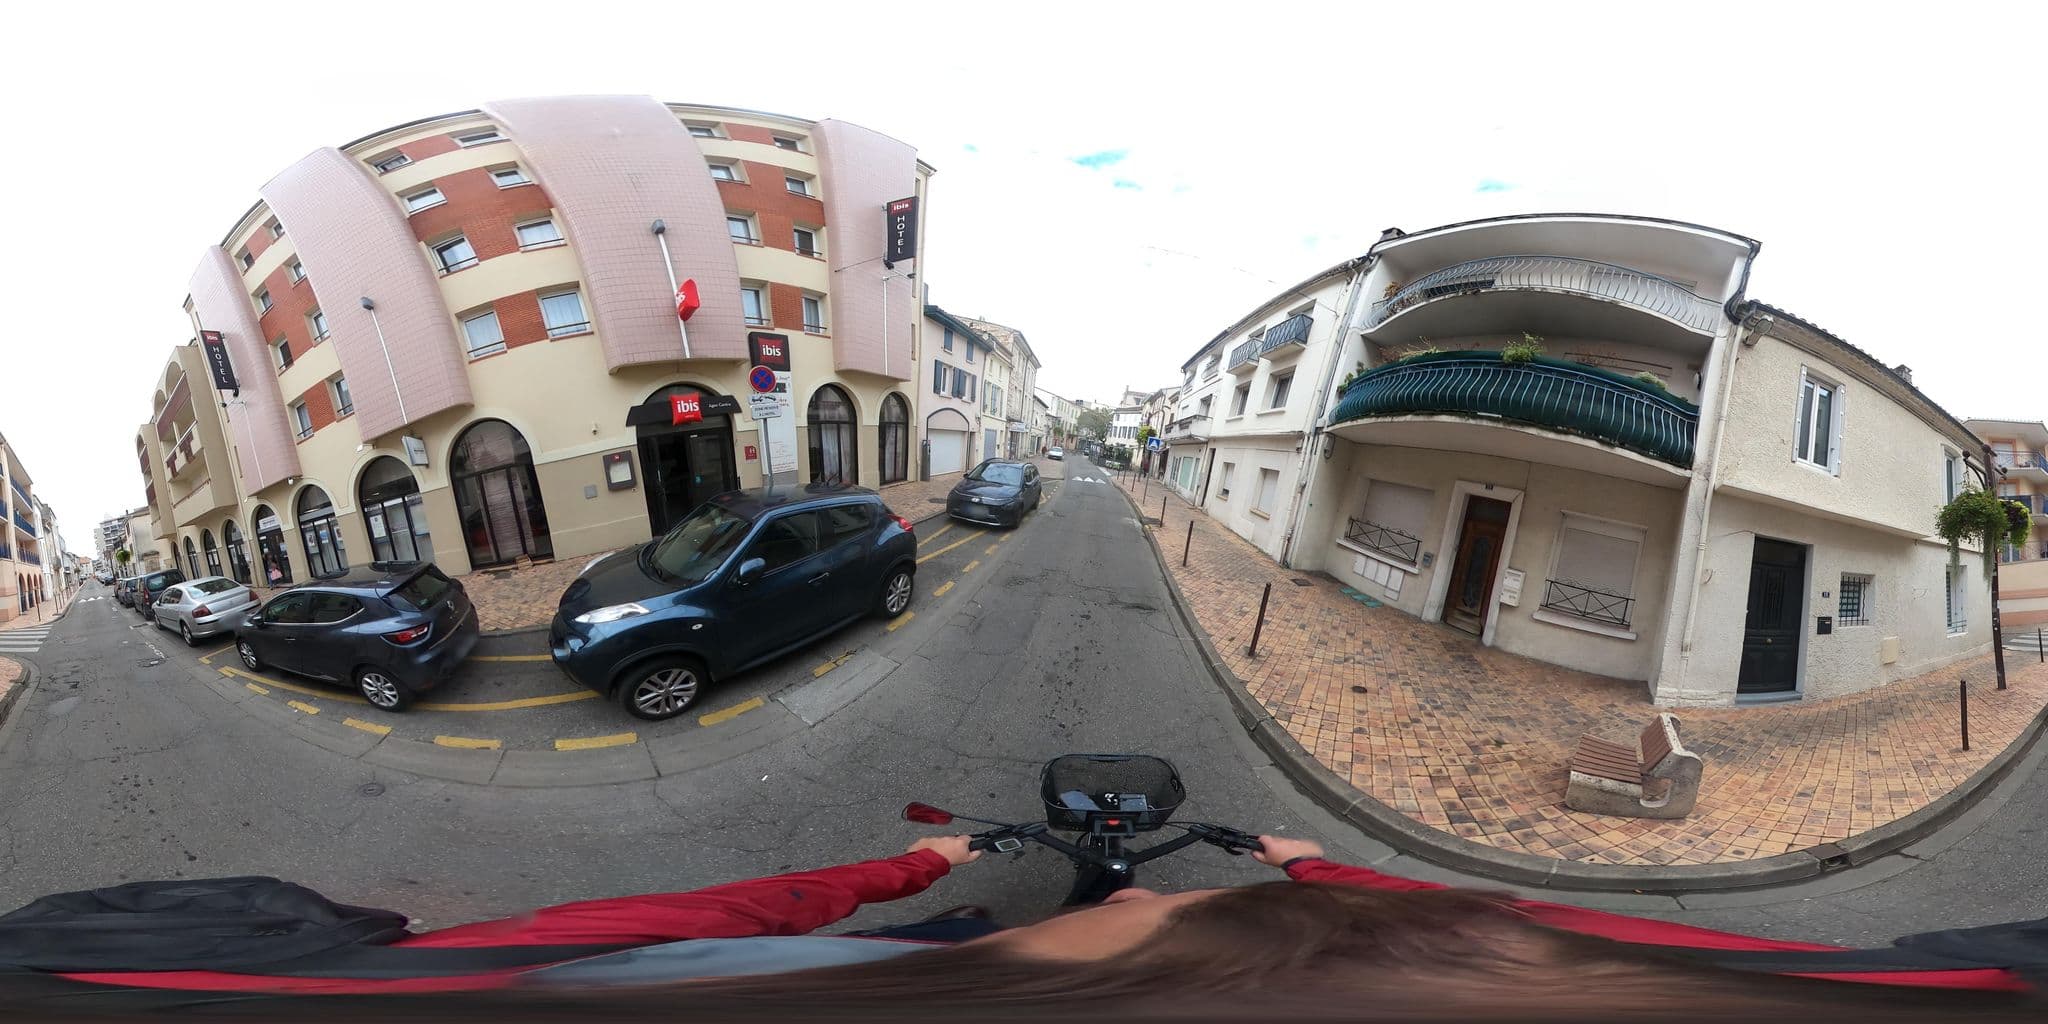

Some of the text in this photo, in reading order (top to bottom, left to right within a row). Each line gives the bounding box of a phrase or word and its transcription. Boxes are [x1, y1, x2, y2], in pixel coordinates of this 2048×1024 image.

[897, 216, 905, 254] HOTEL
[762, 345, 781, 356] ibis
[212, 346, 228, 384] HOTEL
[677, 400, 700, 413] ibis
